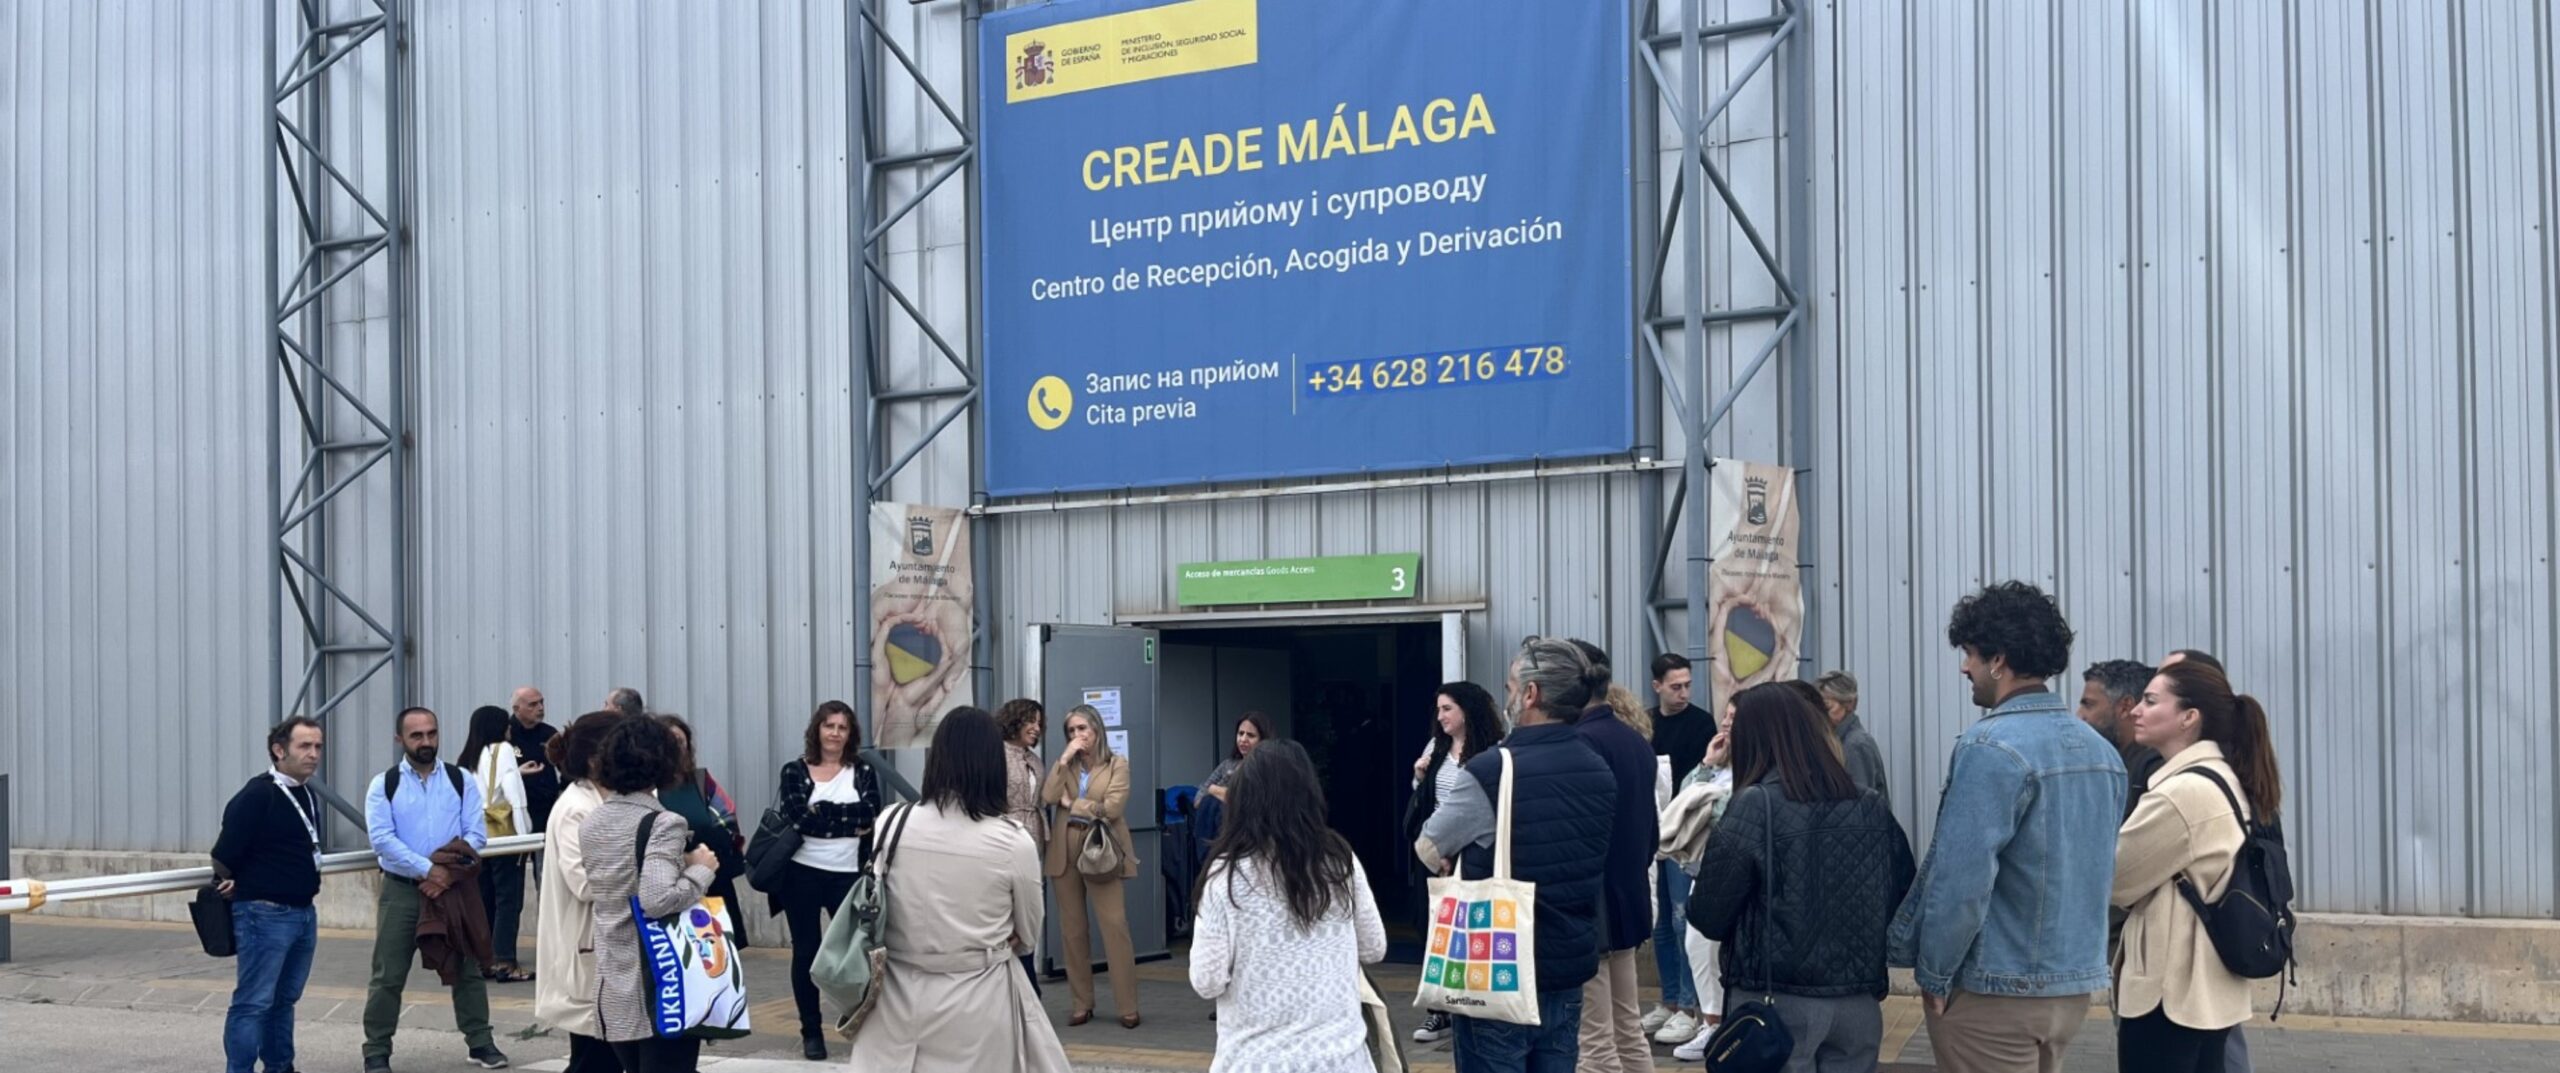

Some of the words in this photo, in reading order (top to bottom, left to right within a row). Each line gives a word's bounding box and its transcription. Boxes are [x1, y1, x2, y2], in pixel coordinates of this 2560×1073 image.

[1061, 43, 1101, 57] GOBIERNO
[1121, 33, 1162, 45] MINISTERIO
[1121, 48, 1131, 56] DE
[1176, 34, 1217, 48] SEGURIDAD
[1219, 27, 1247, 41] SOCIAL
[1061, 57, 1071, 66] DE
[1072, 52, 1101, 65] ESPAÑA
[1121, 57, 1127, 65] Y
[1128, 49, 1178, 63] MIGRACIONES
[1081, 126, 1264, 191] CREADE
[1277, 92, 1496, 166] MÁLAGA
[1090, 215, 1173, 248] Центр
[1180, 198, 1304, 238] прийому
[1327, 173, 1487, 220] супроводу
[1031, 275, 1105, 301] Centro
[1111, 267, 1140, 292] de
[1147, 251, 1278, 288] Recepción,
[1284, 236, 1389, 273] Acogida
[1396, 239, 1412, 266] y
[1419, 215, 1562, 257] Derivación
[1086, 372, 1152, 394] Запис
[1157, 369, 1184, 388] на
[1190, 359, 1279, 390] прийом
[1308, 363, 1364, 393] +34
[1372, 357, 1427, 389] 628
[1437, 354, 1495, 383] 216
[1504, 346, 1565, 377] 478
[1086, 403, 1126, 426] Cita
[1132, 397, 1197, 427] previa
[1185, 570, 1210, 579] Acceso
[1211, 568, 1222, 577] de
[1266, 565, 1289, 575] Goods
[1290, 564, 1315, 575] Access
[1391, 567, 1405, 592] 3
[1445, 995, 1487, 1007] Santillana
